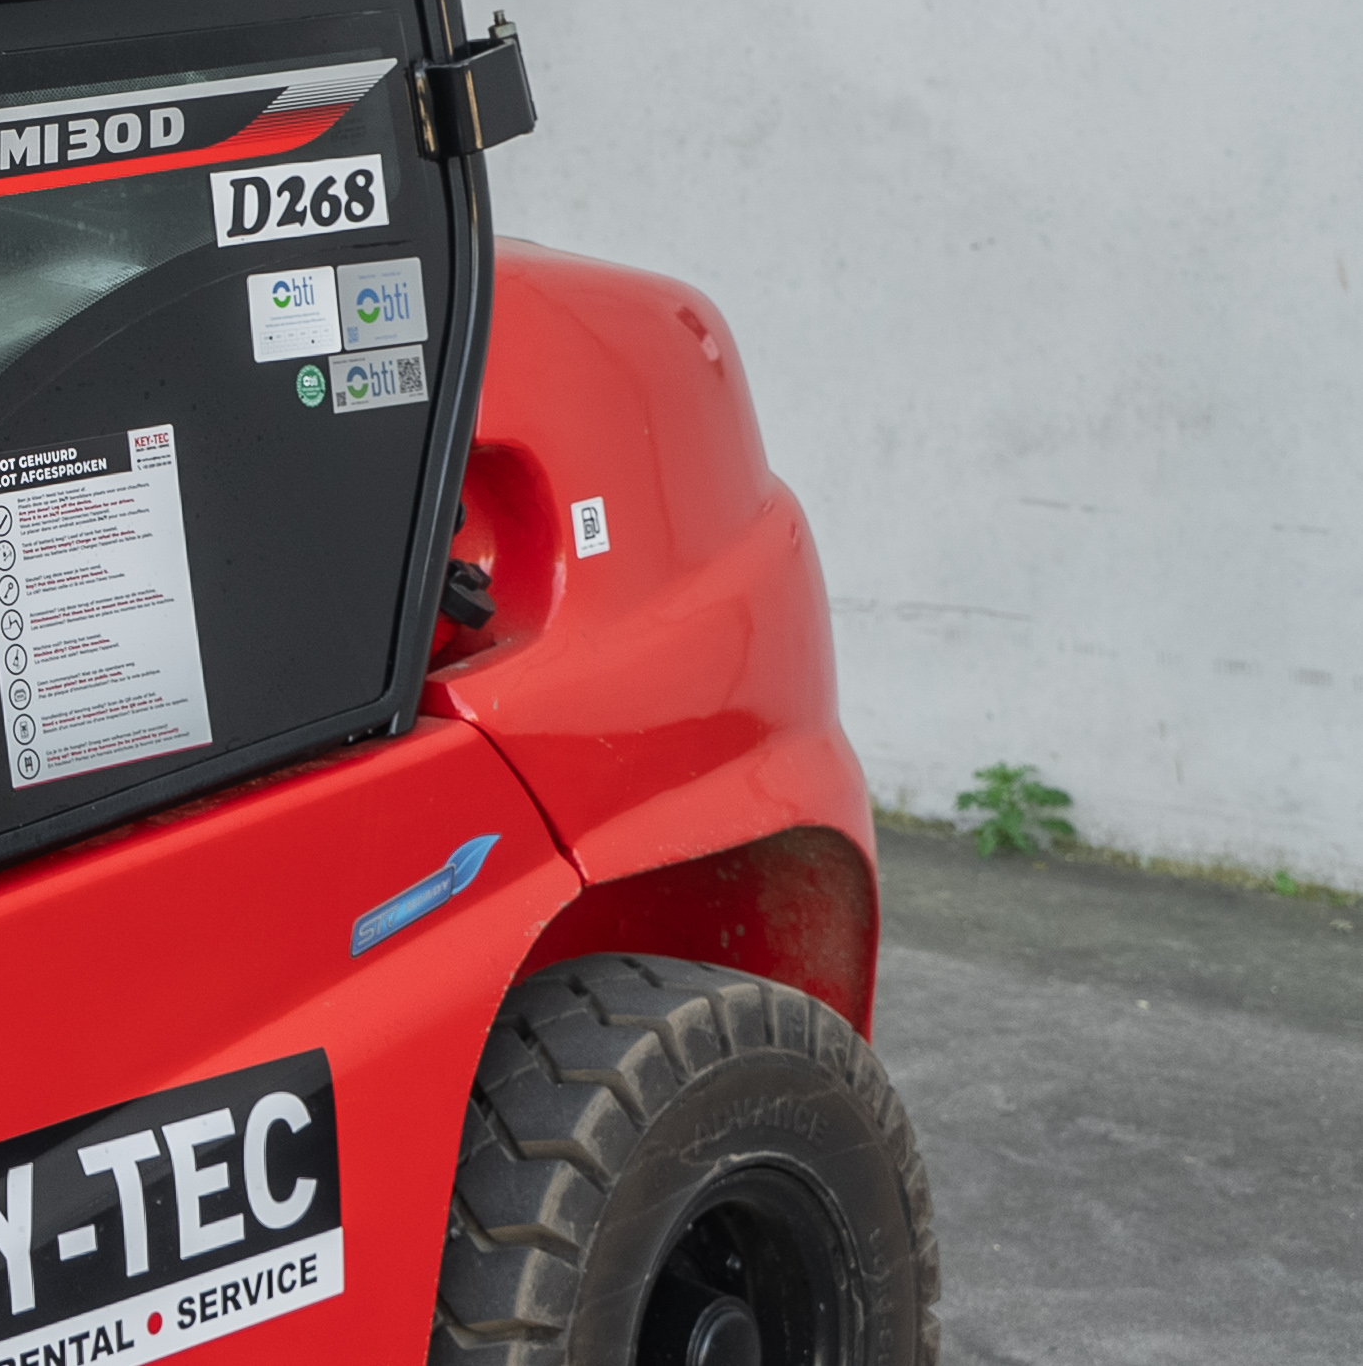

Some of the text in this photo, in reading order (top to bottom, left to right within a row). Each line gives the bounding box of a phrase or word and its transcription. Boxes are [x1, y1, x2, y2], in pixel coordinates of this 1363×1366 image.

[226, 168, 375, 238] D268
[134, 432, 170, 448] KEY-TEC
[18, 447, 78, 470] GEHUURD
[20, 457, 108, 484] AFGESPROKEN
[177, 1253, 319, 1331] SERVICE
